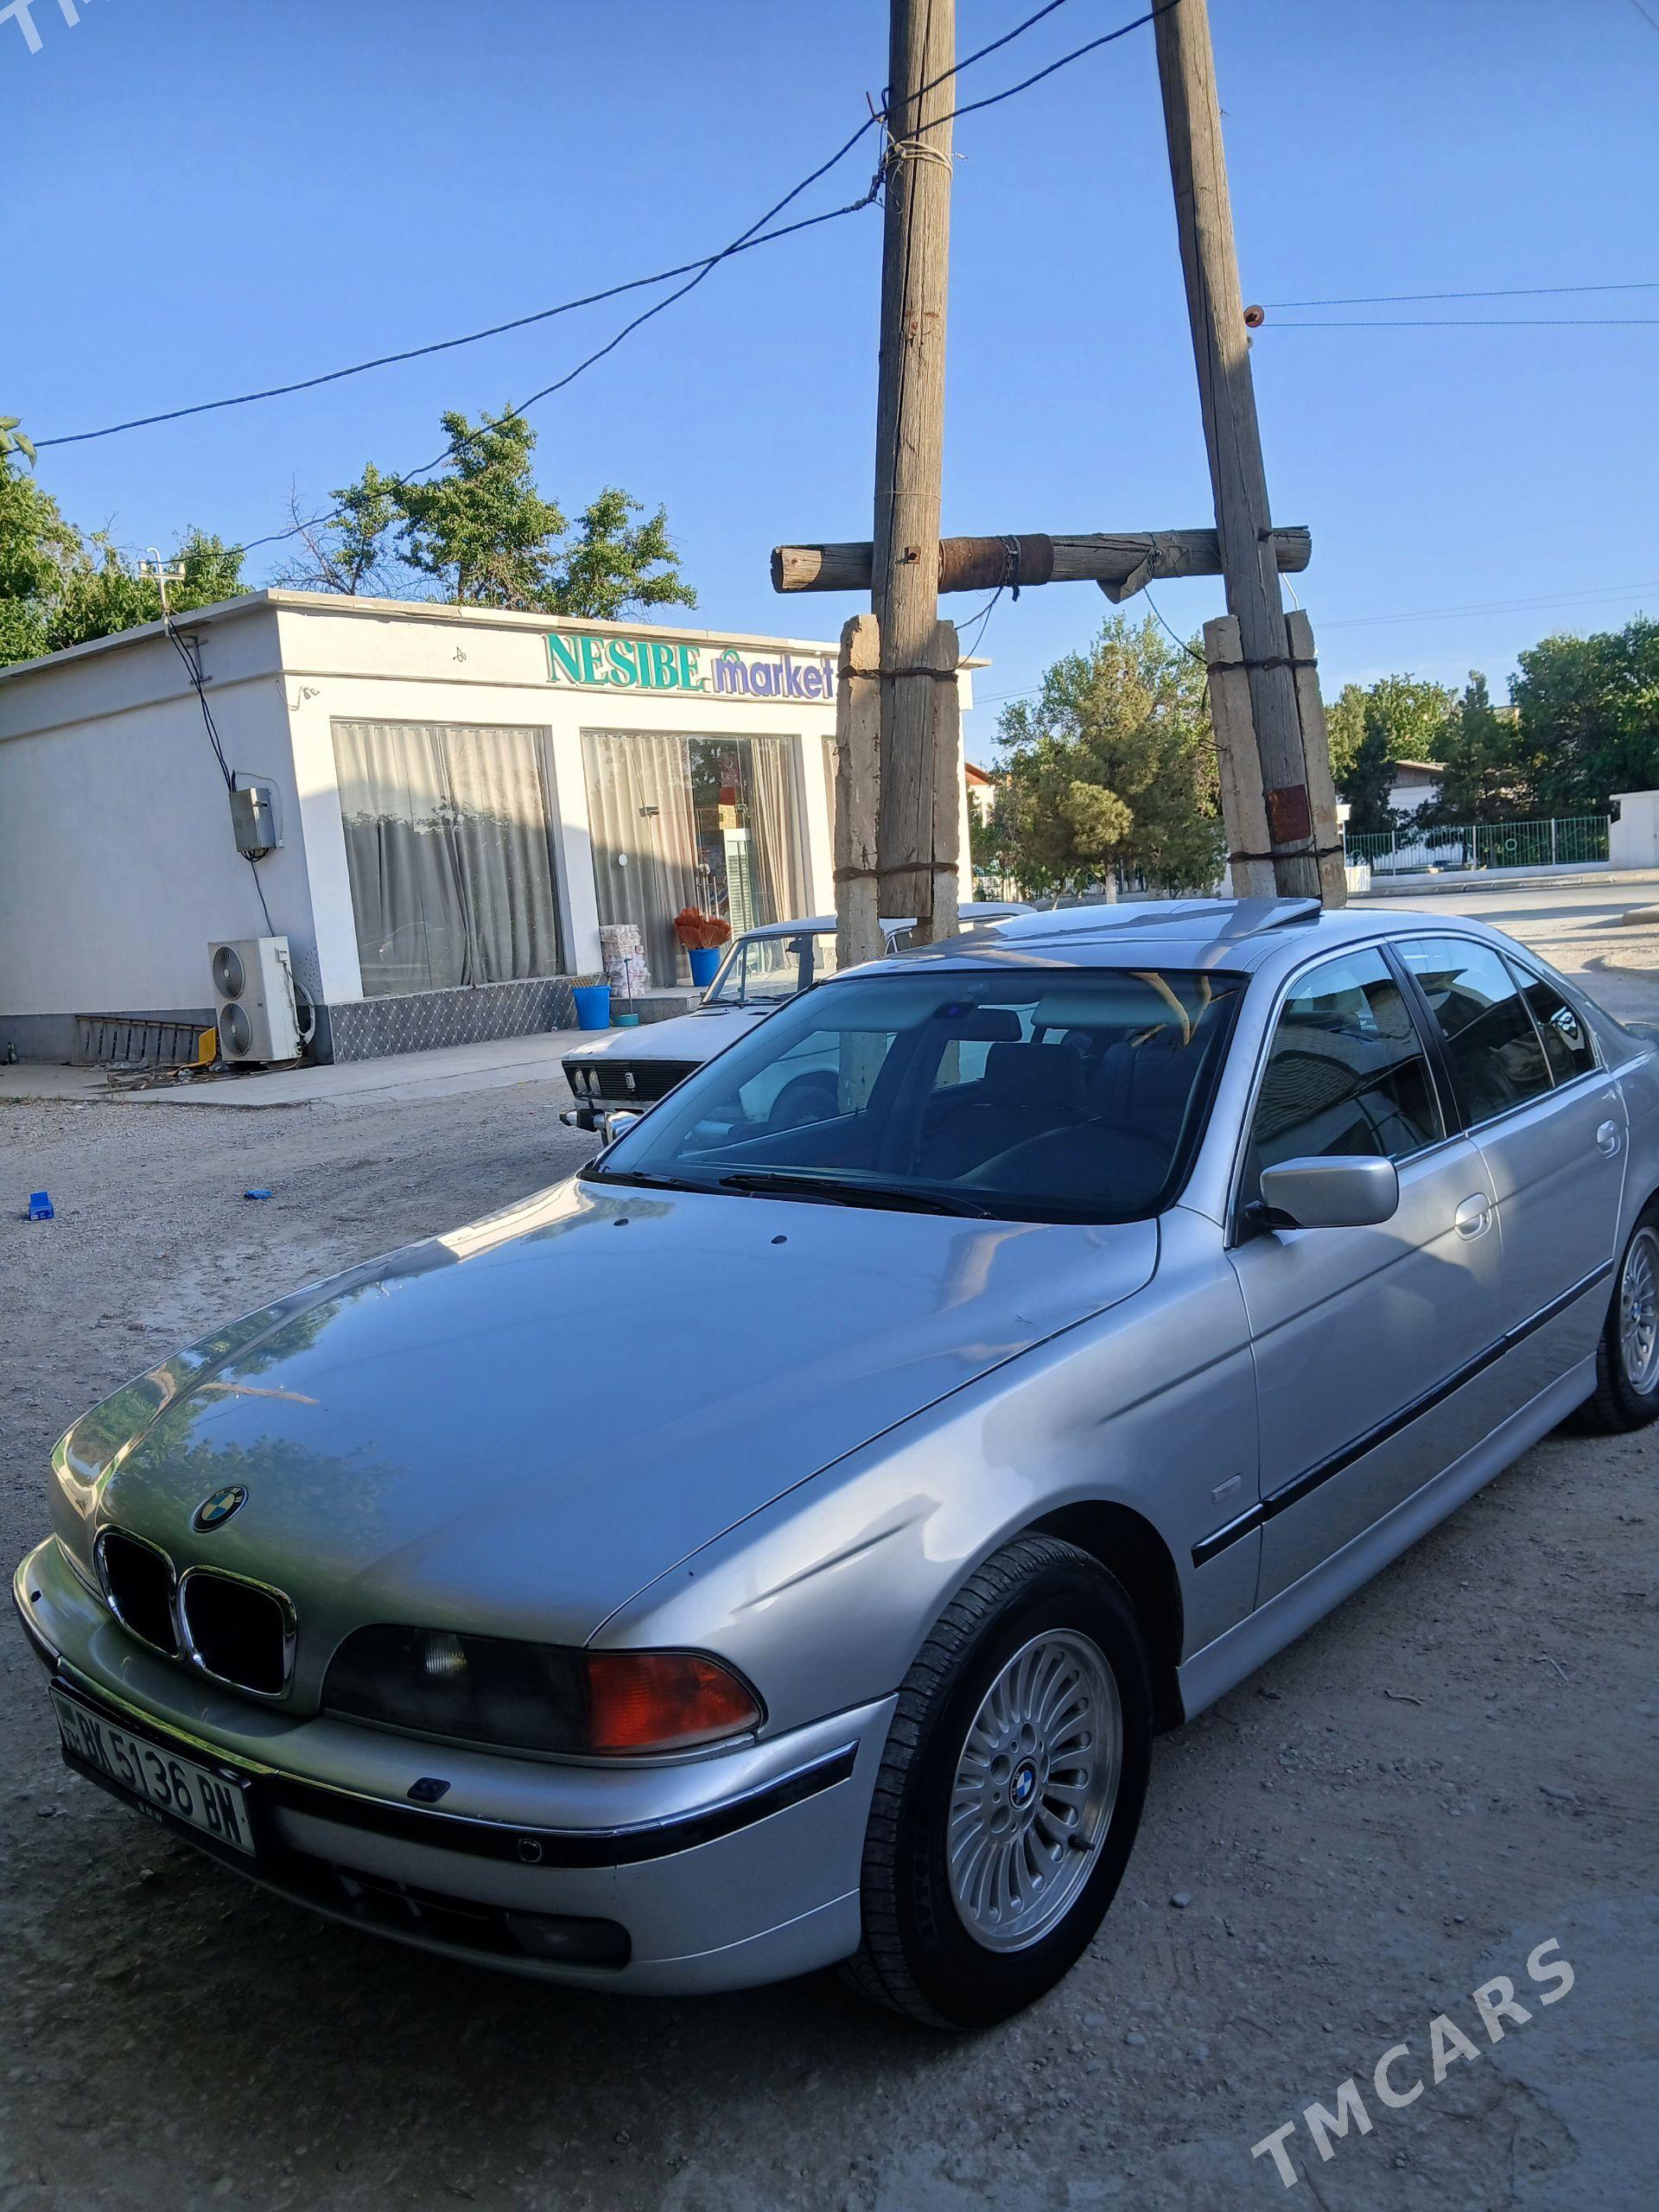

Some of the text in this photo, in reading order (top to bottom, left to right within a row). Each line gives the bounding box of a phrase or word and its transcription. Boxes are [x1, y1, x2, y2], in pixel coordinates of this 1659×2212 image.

[542, 632, 835, 699] NESIBE market
[109, 1730, 194, 1815] 5136
[196, 1773, 243, 1845] BN
